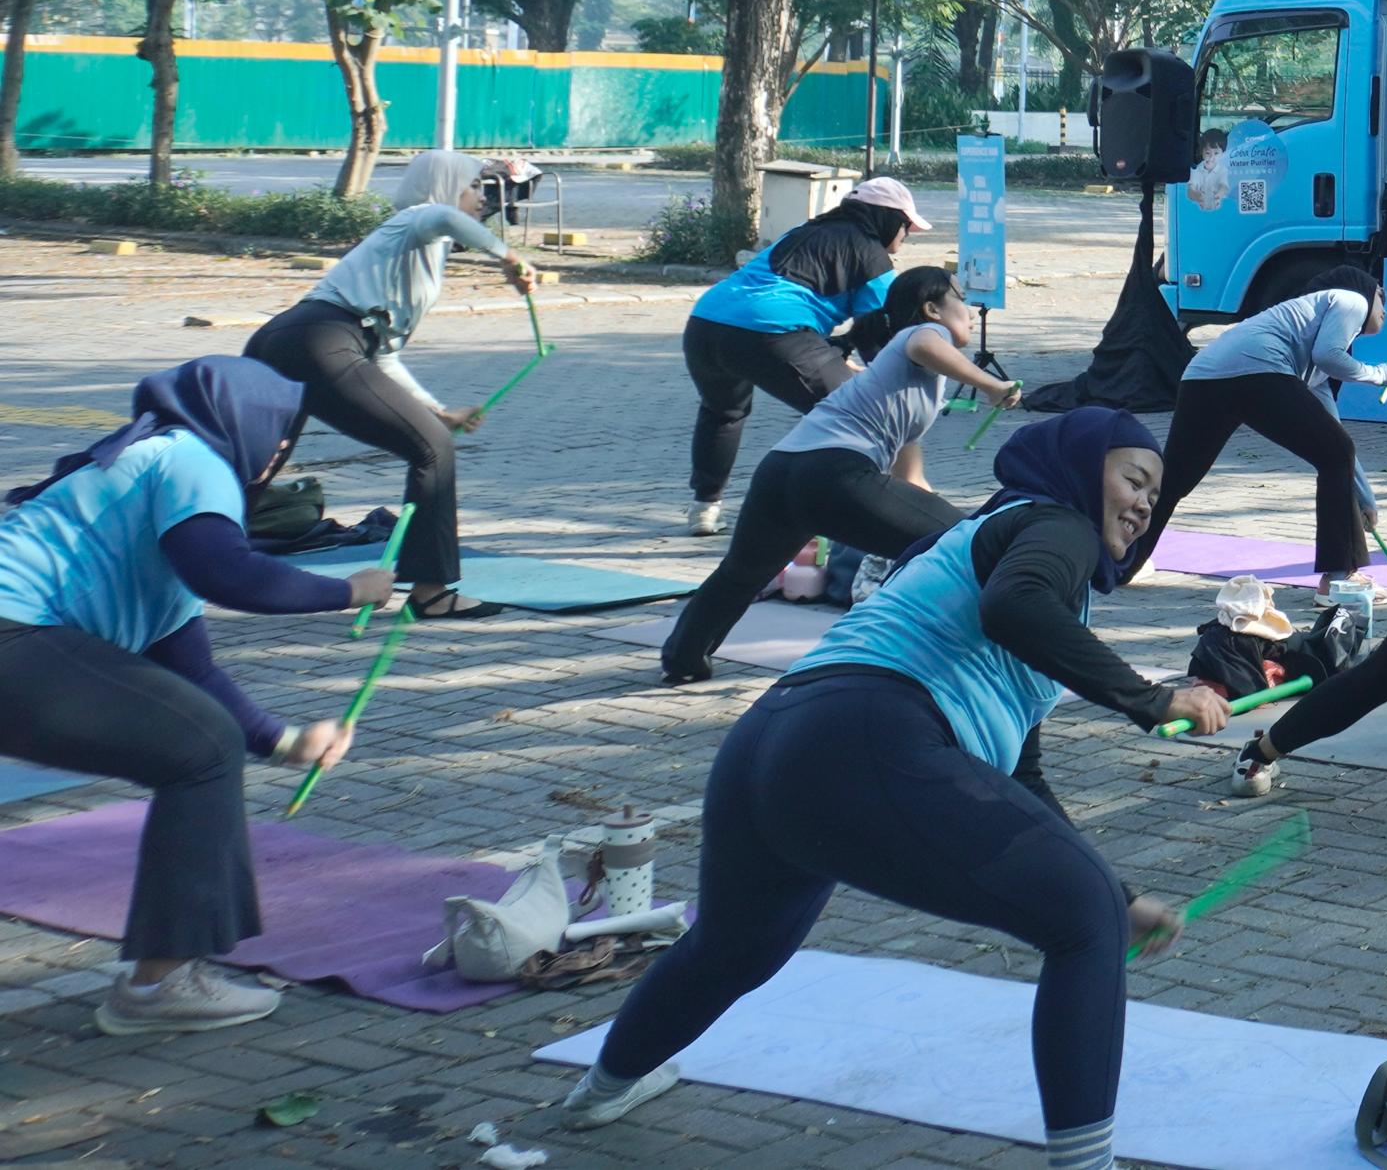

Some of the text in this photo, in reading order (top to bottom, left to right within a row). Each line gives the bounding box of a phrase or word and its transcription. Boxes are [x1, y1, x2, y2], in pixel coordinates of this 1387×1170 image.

[1250, 144, 1277, 158] Gratis
[1229, 158, 1276, 167] Water Purifier
